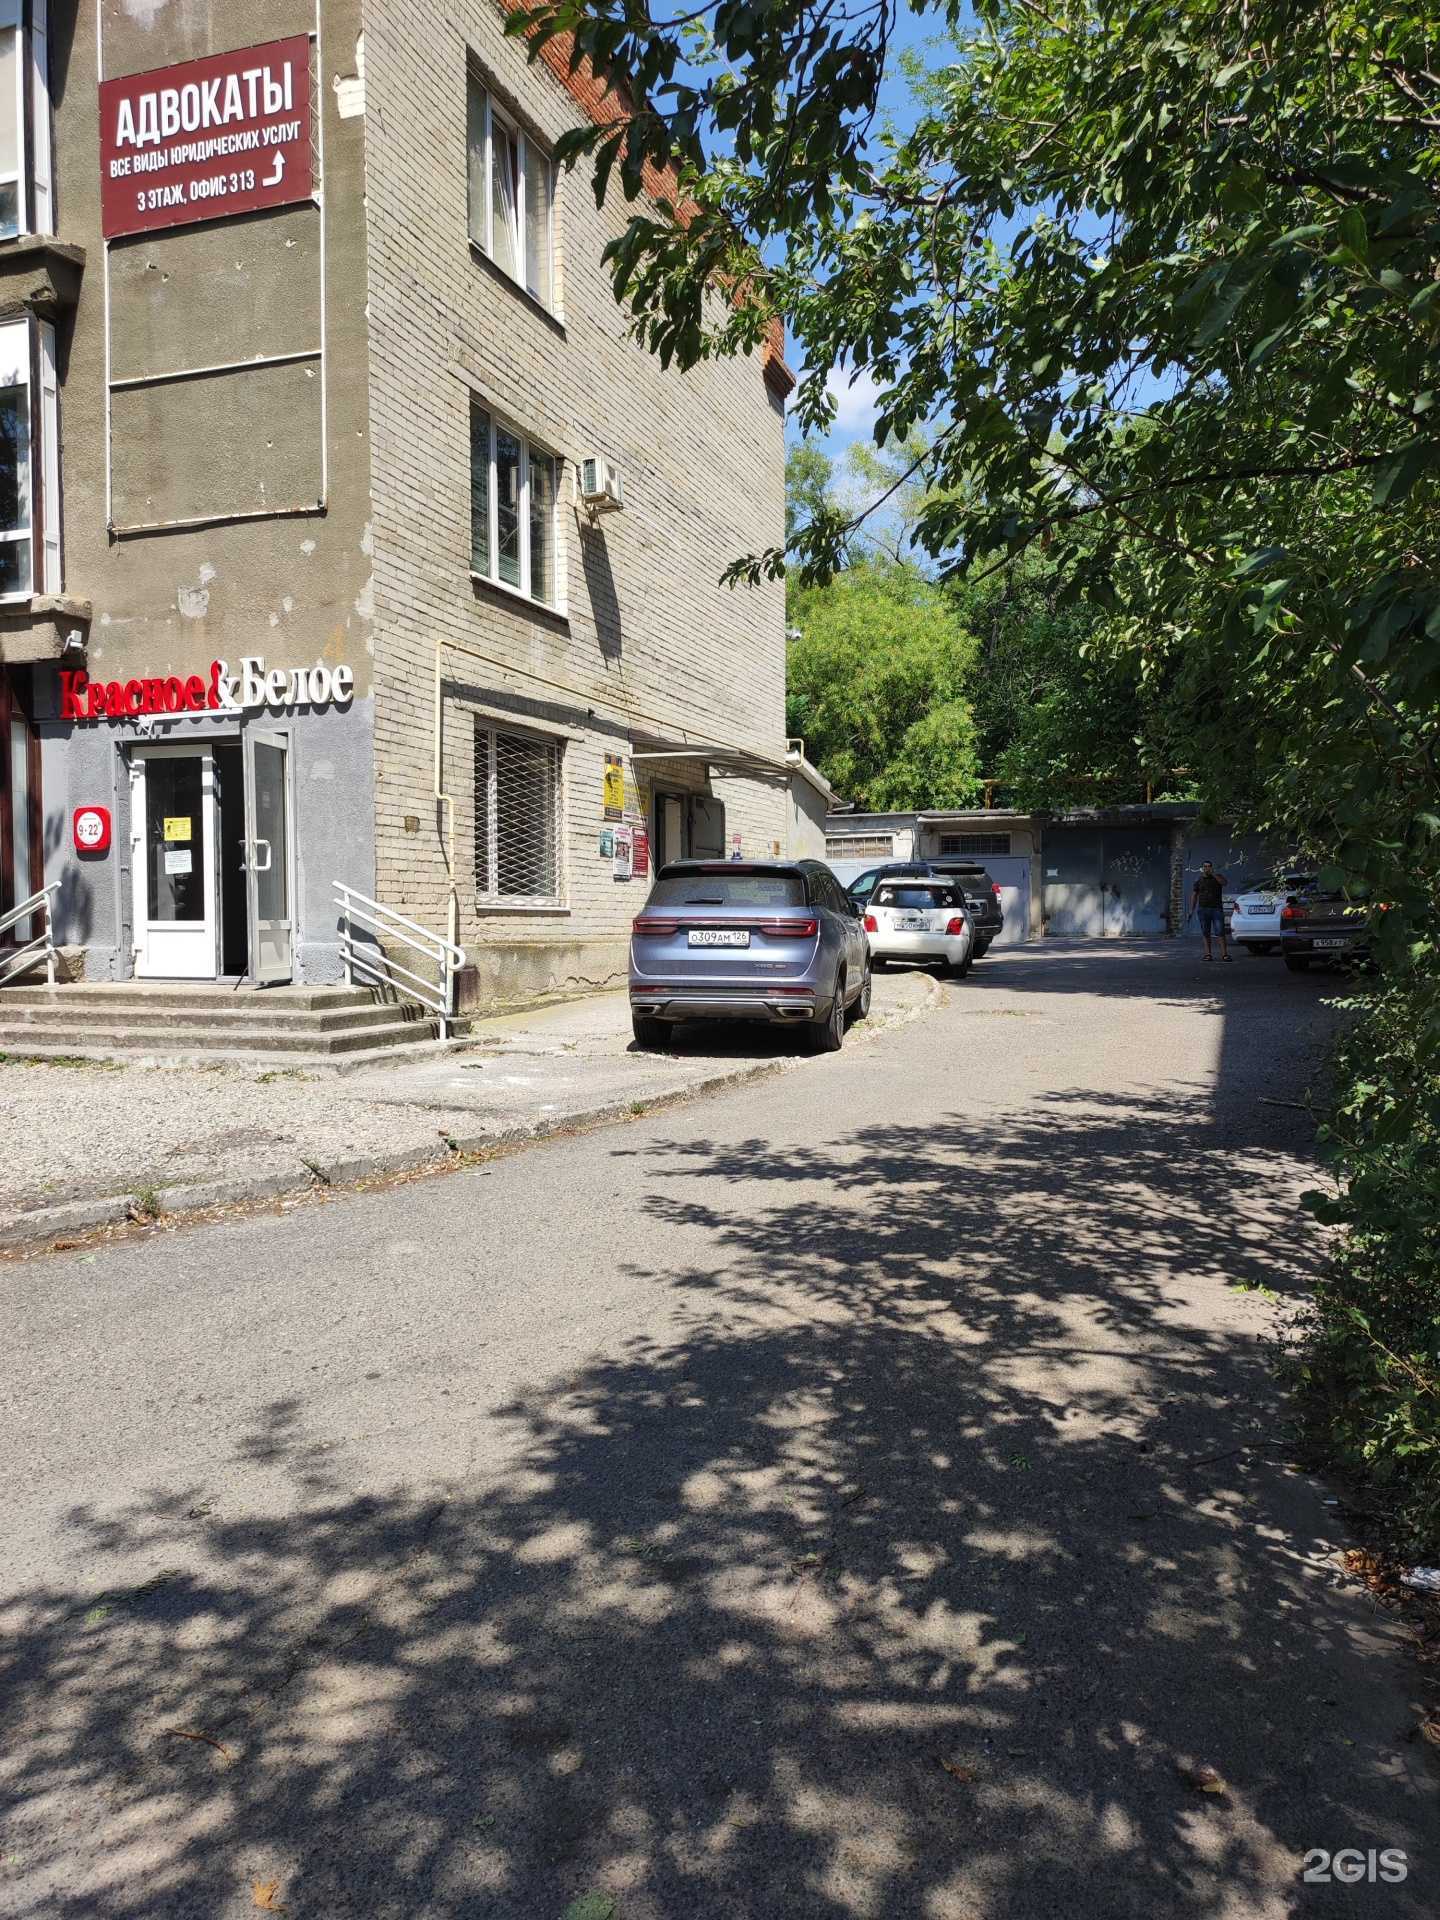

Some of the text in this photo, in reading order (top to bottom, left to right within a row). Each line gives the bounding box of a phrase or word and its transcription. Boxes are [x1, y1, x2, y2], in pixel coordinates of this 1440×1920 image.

[116, 62, 292, 148] АДВОКАТЫ
[110, 121, 301, 178] ВСЕ ВИДЫ ЮРИДИЧЕСКИХ УСЛУГ
[137, 169, 255, 211] 3 ЭТАЖ, ОФИС 313
